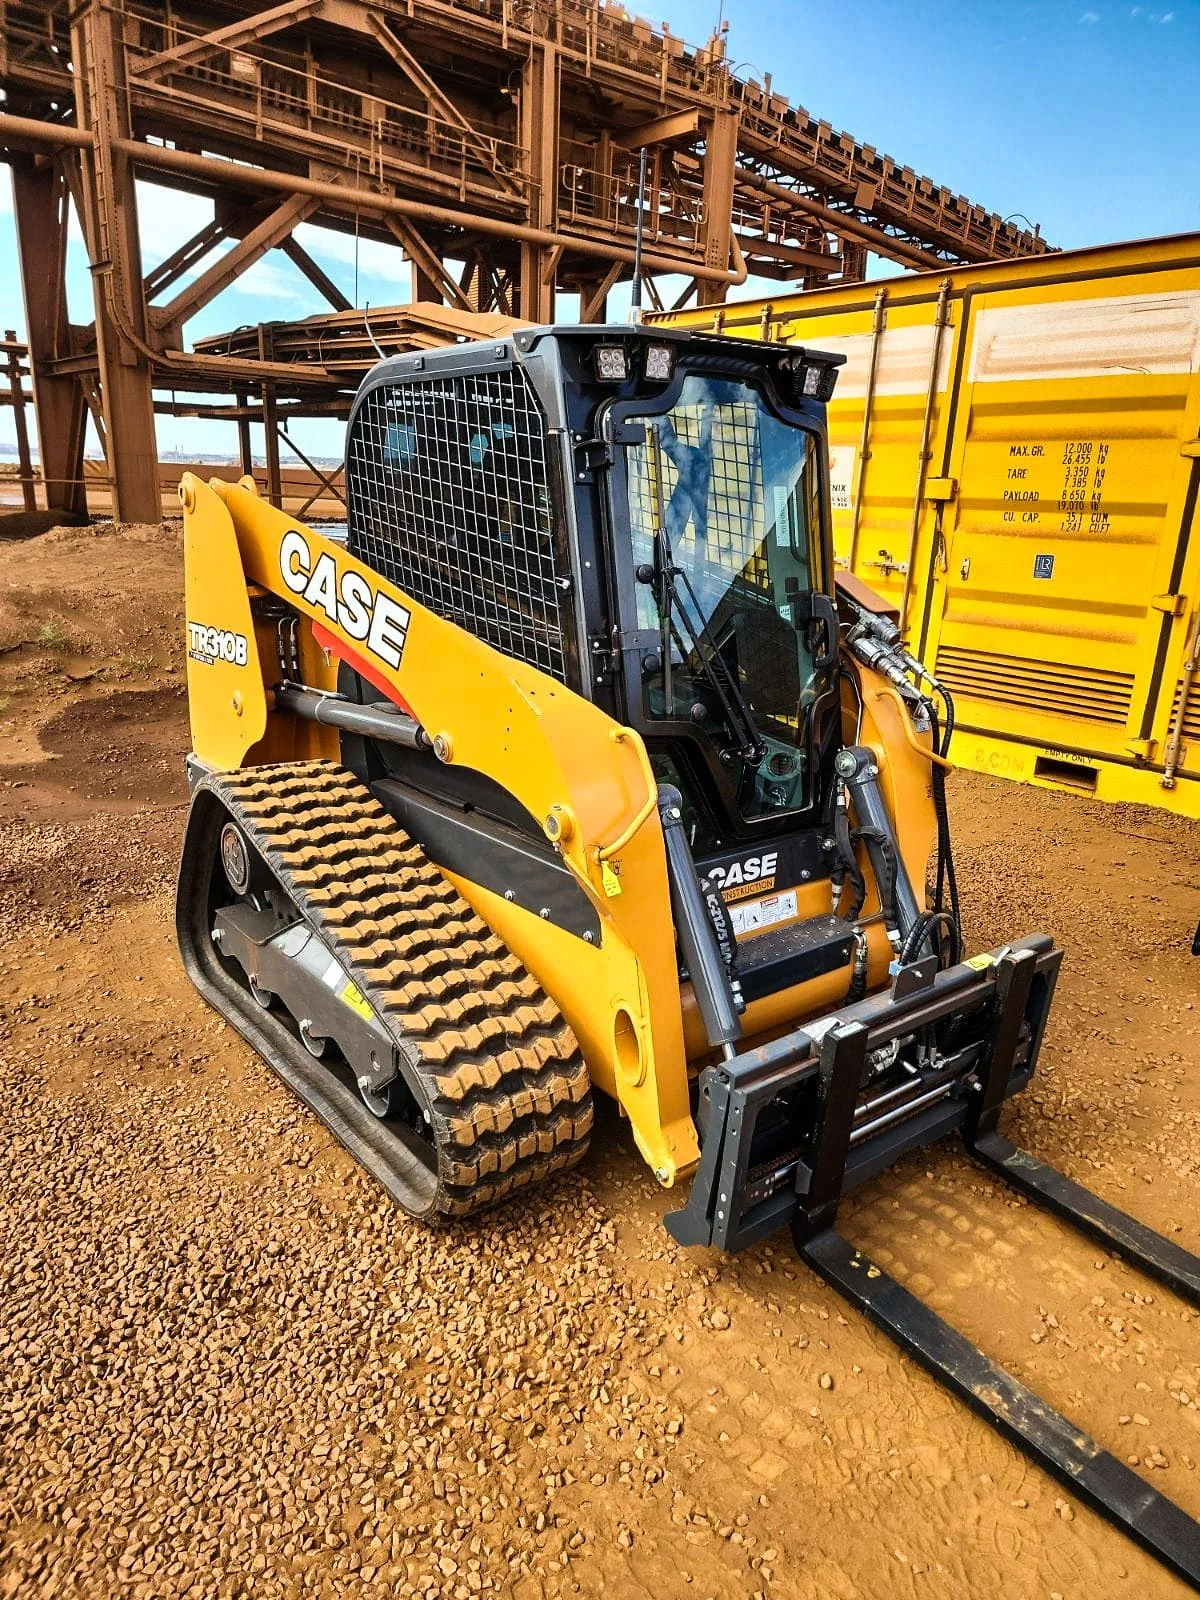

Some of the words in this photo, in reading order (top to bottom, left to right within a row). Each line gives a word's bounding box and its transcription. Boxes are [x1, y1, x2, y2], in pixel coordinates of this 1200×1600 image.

[1065, 443, 1092, 454] 12.000
[1099, 443, 1109, 455] kg
[1062, 454, 1090, 464] 26.455
[1097, 454, 1106, 464] lb
[1007, 468, 1028, 478] TARE
[1065, 467, 1089, 477] 3.350
[1095, 467, 1105, 479] kg
[832, 484, 847, 492] NIX
[1064, 478, 1087, 488] 7.385
[1093, 478, 1102, 488] lb
[1003, 490, 1040, 501] PAYLOAD
[1062, 490, 1086, 500] 8650
[1091, 491, 1102, 503] kg
[1057, 500, 1084, 511] 19.070
[1090, 501, 1099, 511] lb
[1003, 512, 1016, 522] CU.
[1022, 512, 1041, 523] CAP.
[1066, 512, 1083, 522] 35.1
[280, 530, 411, 671] CASE
[188, 621, 247, 667] TR310B
[708, 852, 778, 889] CASE
[721, 878, 774, 901] ONSTRUCTION
